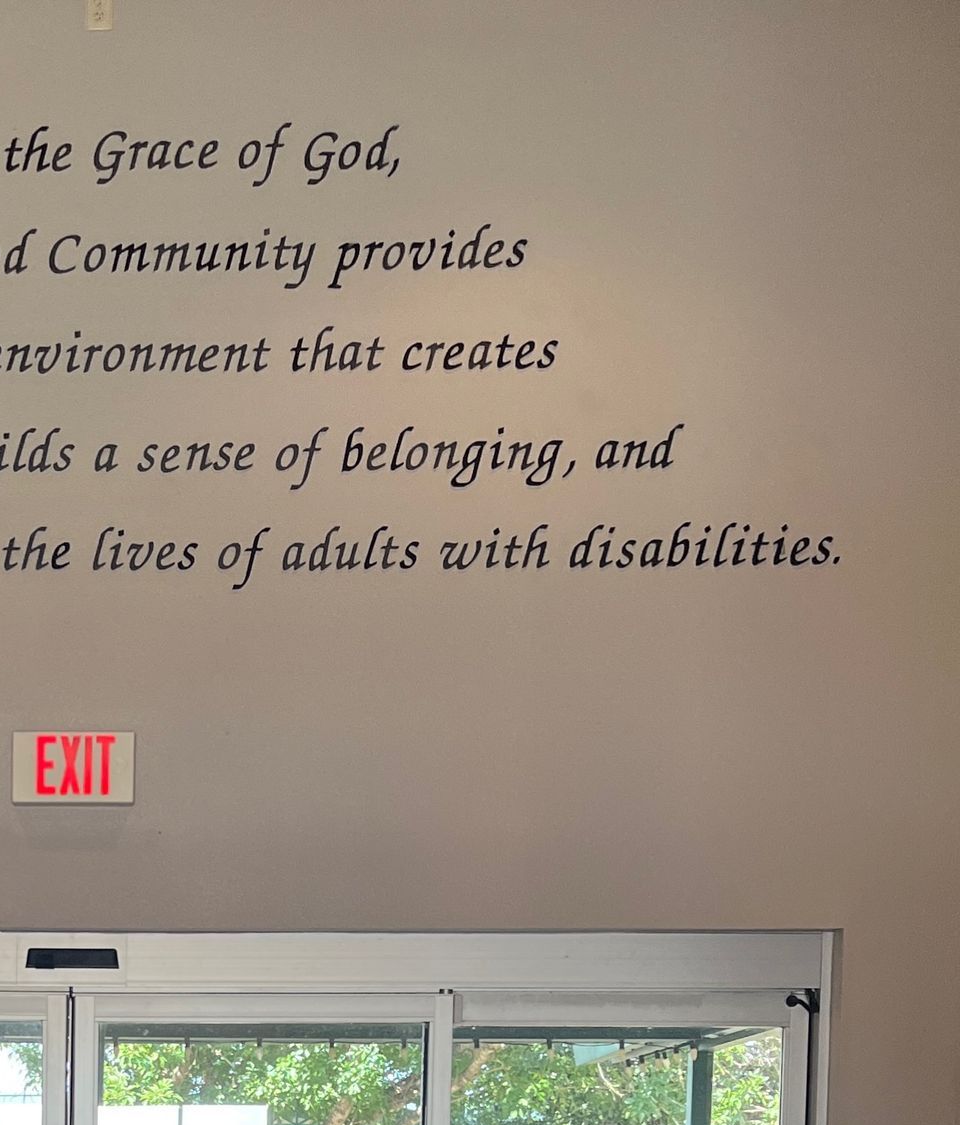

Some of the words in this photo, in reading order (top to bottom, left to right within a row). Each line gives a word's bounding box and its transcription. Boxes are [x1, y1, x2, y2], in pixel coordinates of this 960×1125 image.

[3, 125, 73, 173] the
[93, 130, 219, 185] Grace
[238, 121, 293, 188] of
[303, 123, 400, 186] God,
[48, 227, 317, 290] Community
[326, 223, 529, 290] provides
[289, 325, 386, 373] that
[401, 333, 560, 373] creates
[94, 443, 119, 473] a
[136, 441, 256, 474] sense
[274, 426, 330, 491] of
[337, 425, 577, 489] belonging,
[594, 423, 686, 470] and
[1, 526, 71, 572] the
[92, 526, 199, 572] lives
[217, 526, 272, 591] of
[281, 525, 420, 572] adults
[439, 523, 551, 571] with
[568, 521, 841, 569] disabilities.
[36, 734, 117, 796] EXIT
